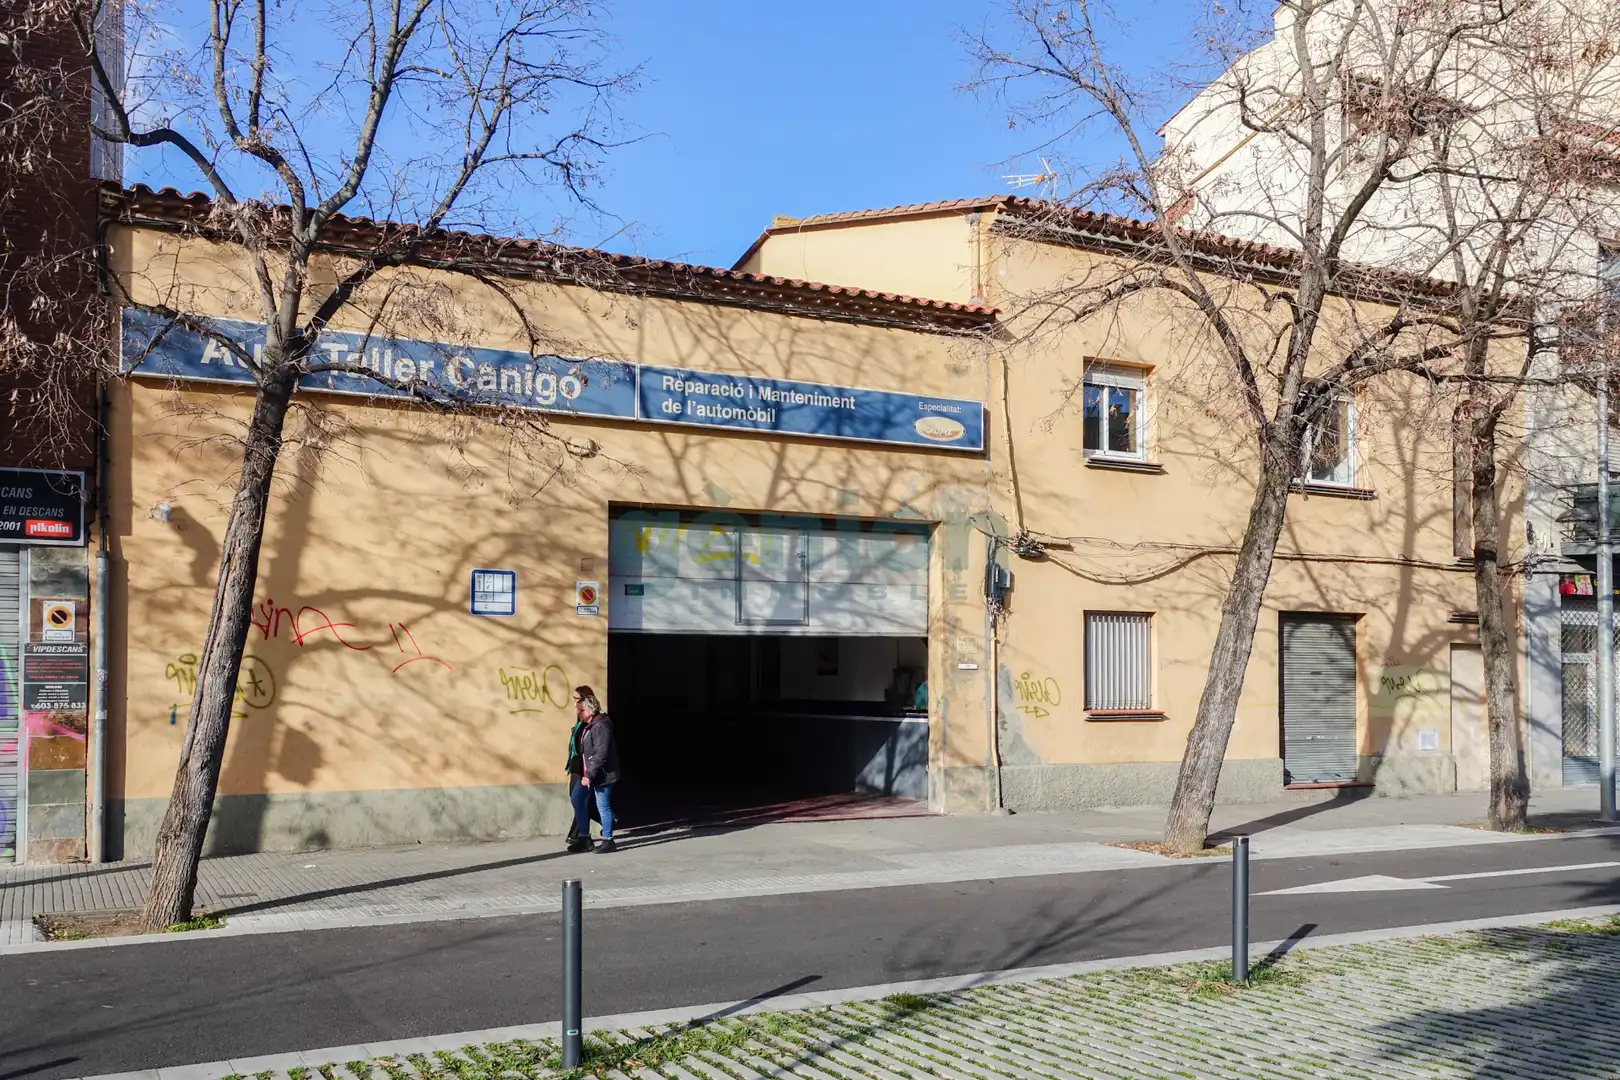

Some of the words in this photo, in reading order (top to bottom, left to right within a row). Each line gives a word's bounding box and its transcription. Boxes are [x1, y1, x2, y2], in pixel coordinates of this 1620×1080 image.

[321, 342, 434, 384] Taller
[448, 354, 581, 405] Canigó
[662, 375, 744, 399] Reparació
[749, 384, 754, 399] i
[758, 385, 856, 410] Manteniment
[662, 398, 683, 414] de
[918, 401, 962, 413] Especialitat:
[3, 505, 17, 515] EN
[19, 506, 65, 517] DESCANS
[0, 521, 21, 531] 2001
[33, 645, 83, 653] VIPDESCANS
